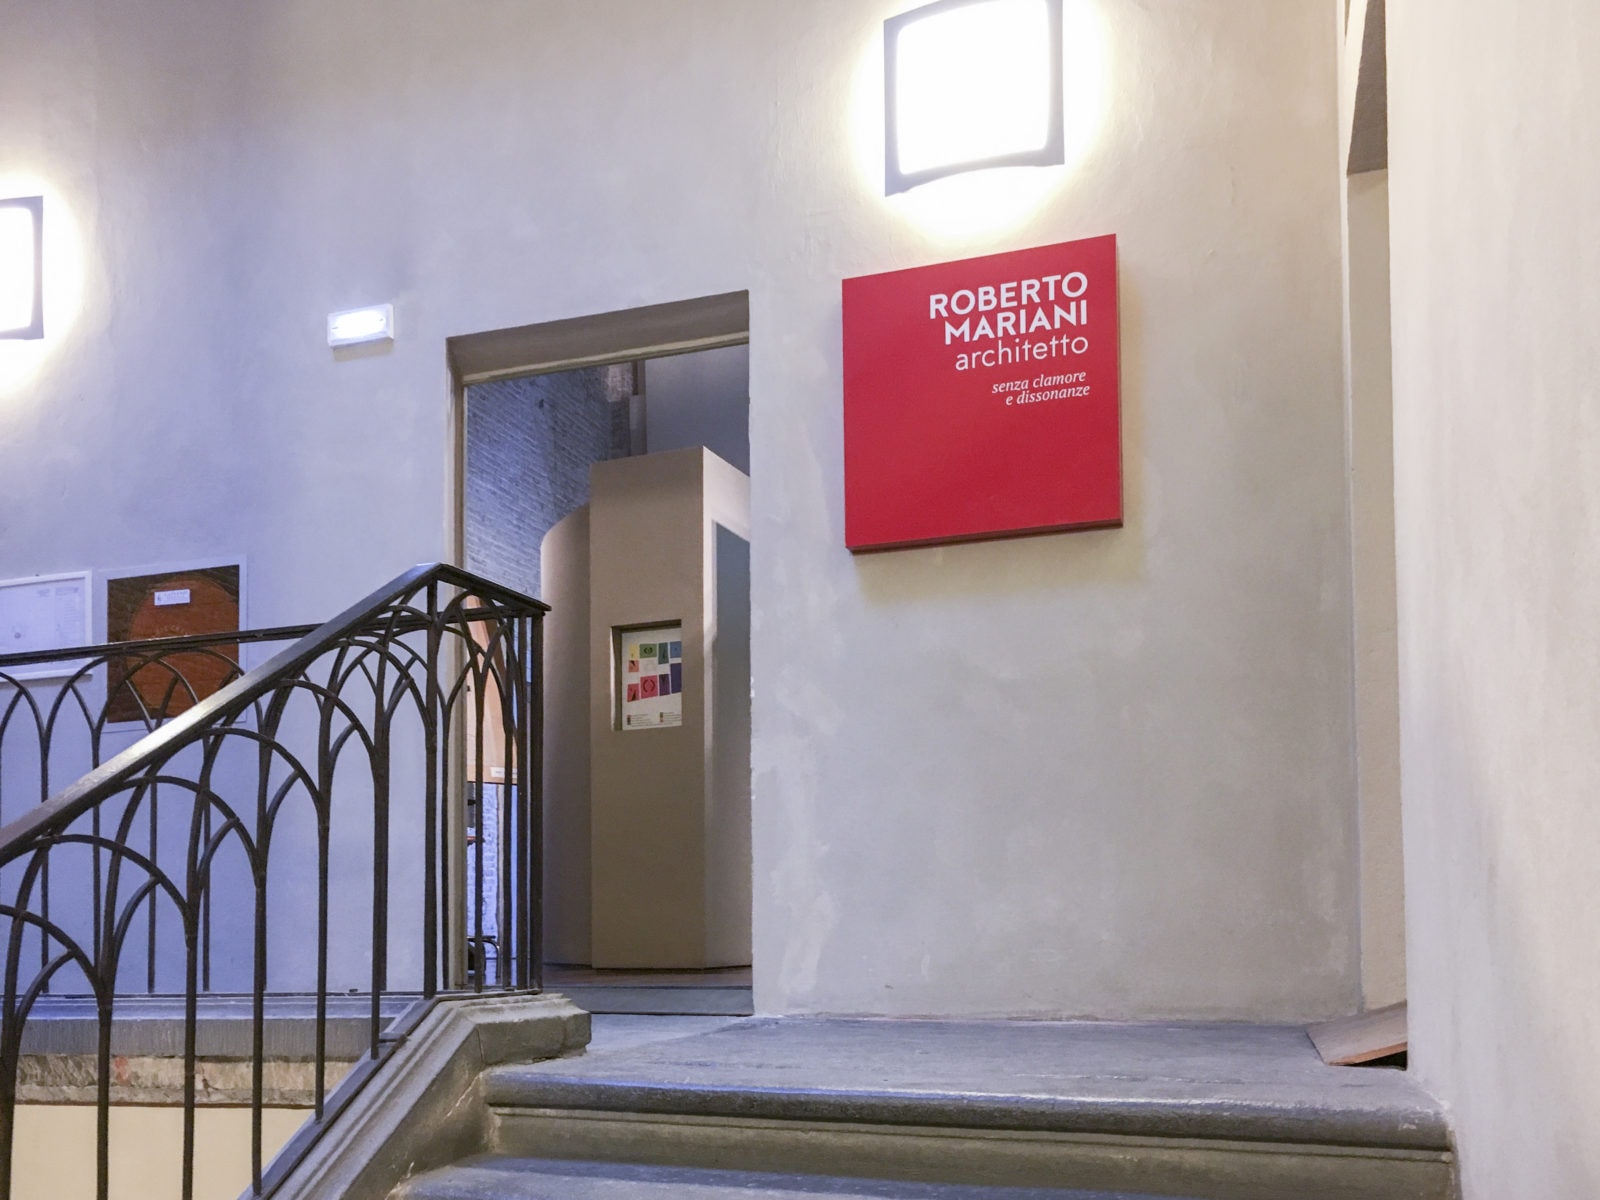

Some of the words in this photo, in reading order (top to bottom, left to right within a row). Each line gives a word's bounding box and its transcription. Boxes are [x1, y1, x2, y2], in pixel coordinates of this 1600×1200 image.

[929, 271, 1088, 320] ROBERTO
[944, 300, 1088, 345] MARIANI
[955, 333, 1089, 371] architetto
[991, 379, 1029, 394] senza
[1032, 371, 1087, 389] clamore
[1005, 395, 1014, 406] e
[1016, 385, 1091, 405] dissonanze
